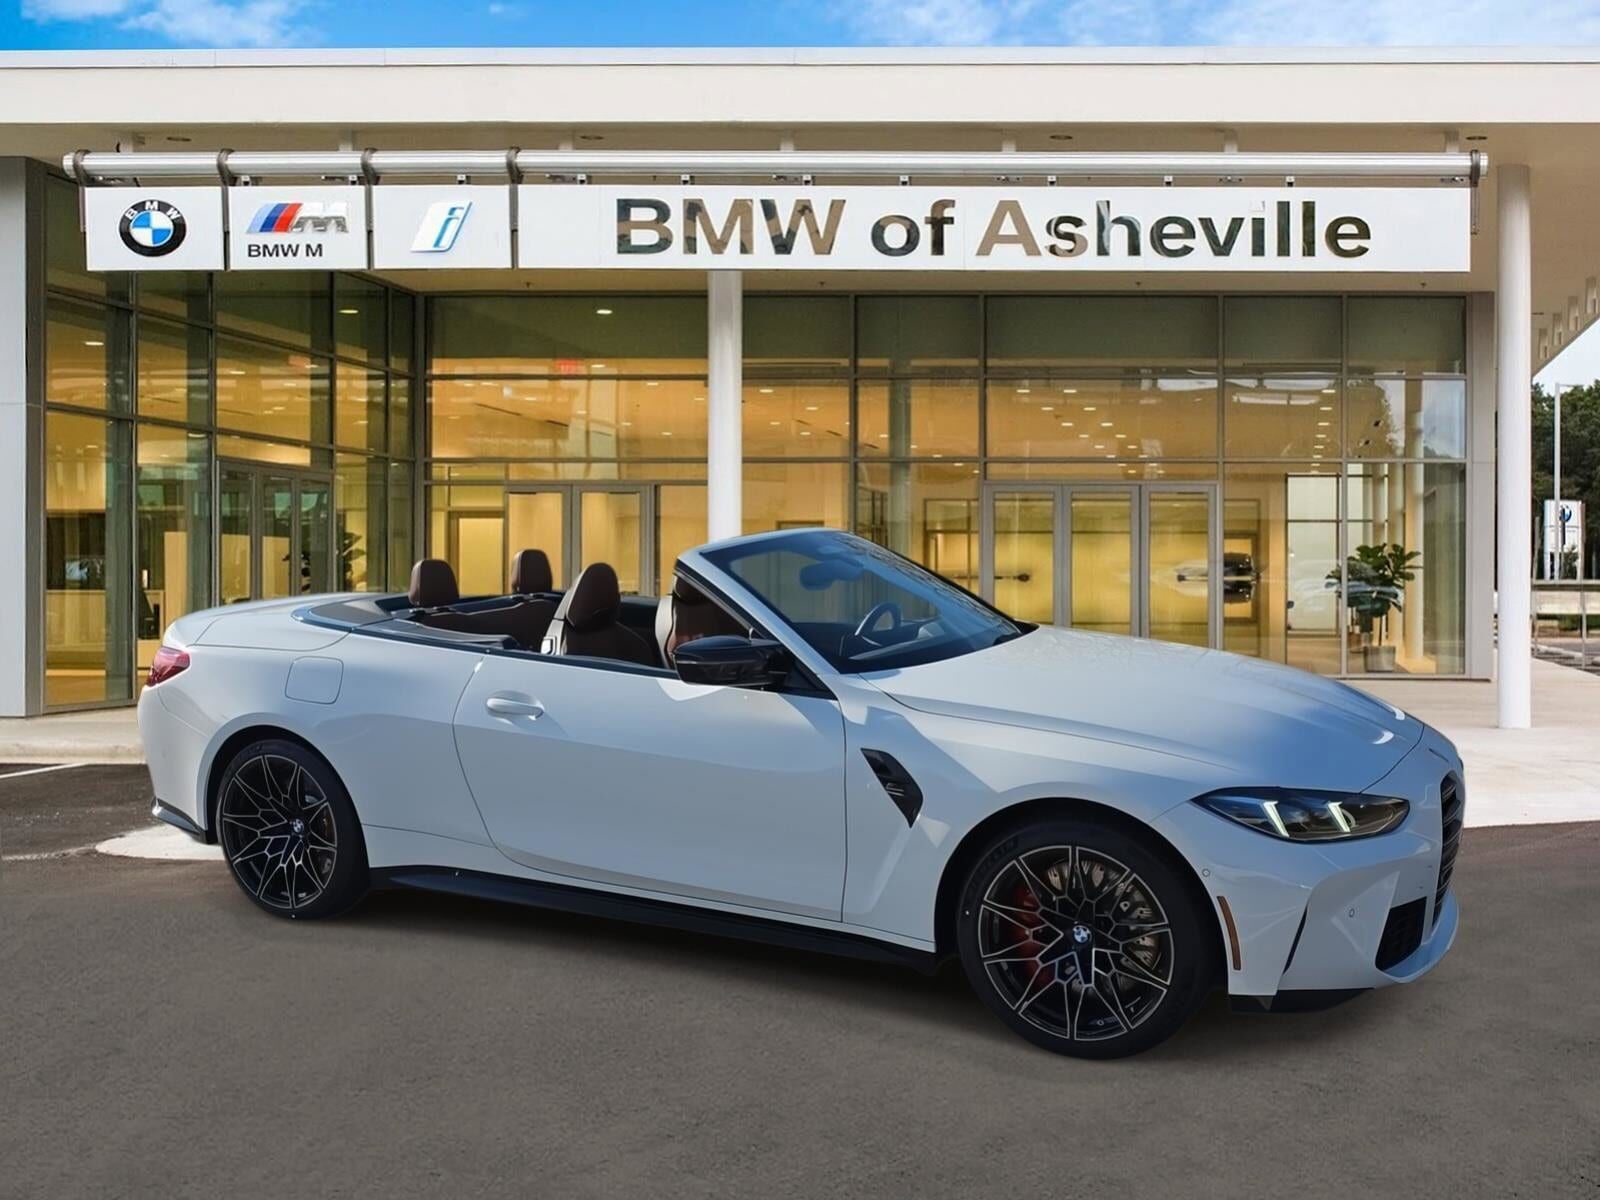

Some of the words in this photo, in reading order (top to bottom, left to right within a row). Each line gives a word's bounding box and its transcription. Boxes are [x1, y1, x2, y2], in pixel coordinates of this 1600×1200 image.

[125, 200, 181, 220] BMW
[616, 199, 847, 255] BMW
[871, 199, 956, 257] of
[975, 200, 1371, 258] Asheville
[248, 244, 300, 257] BMW
[305, 243, 323, 257] M
